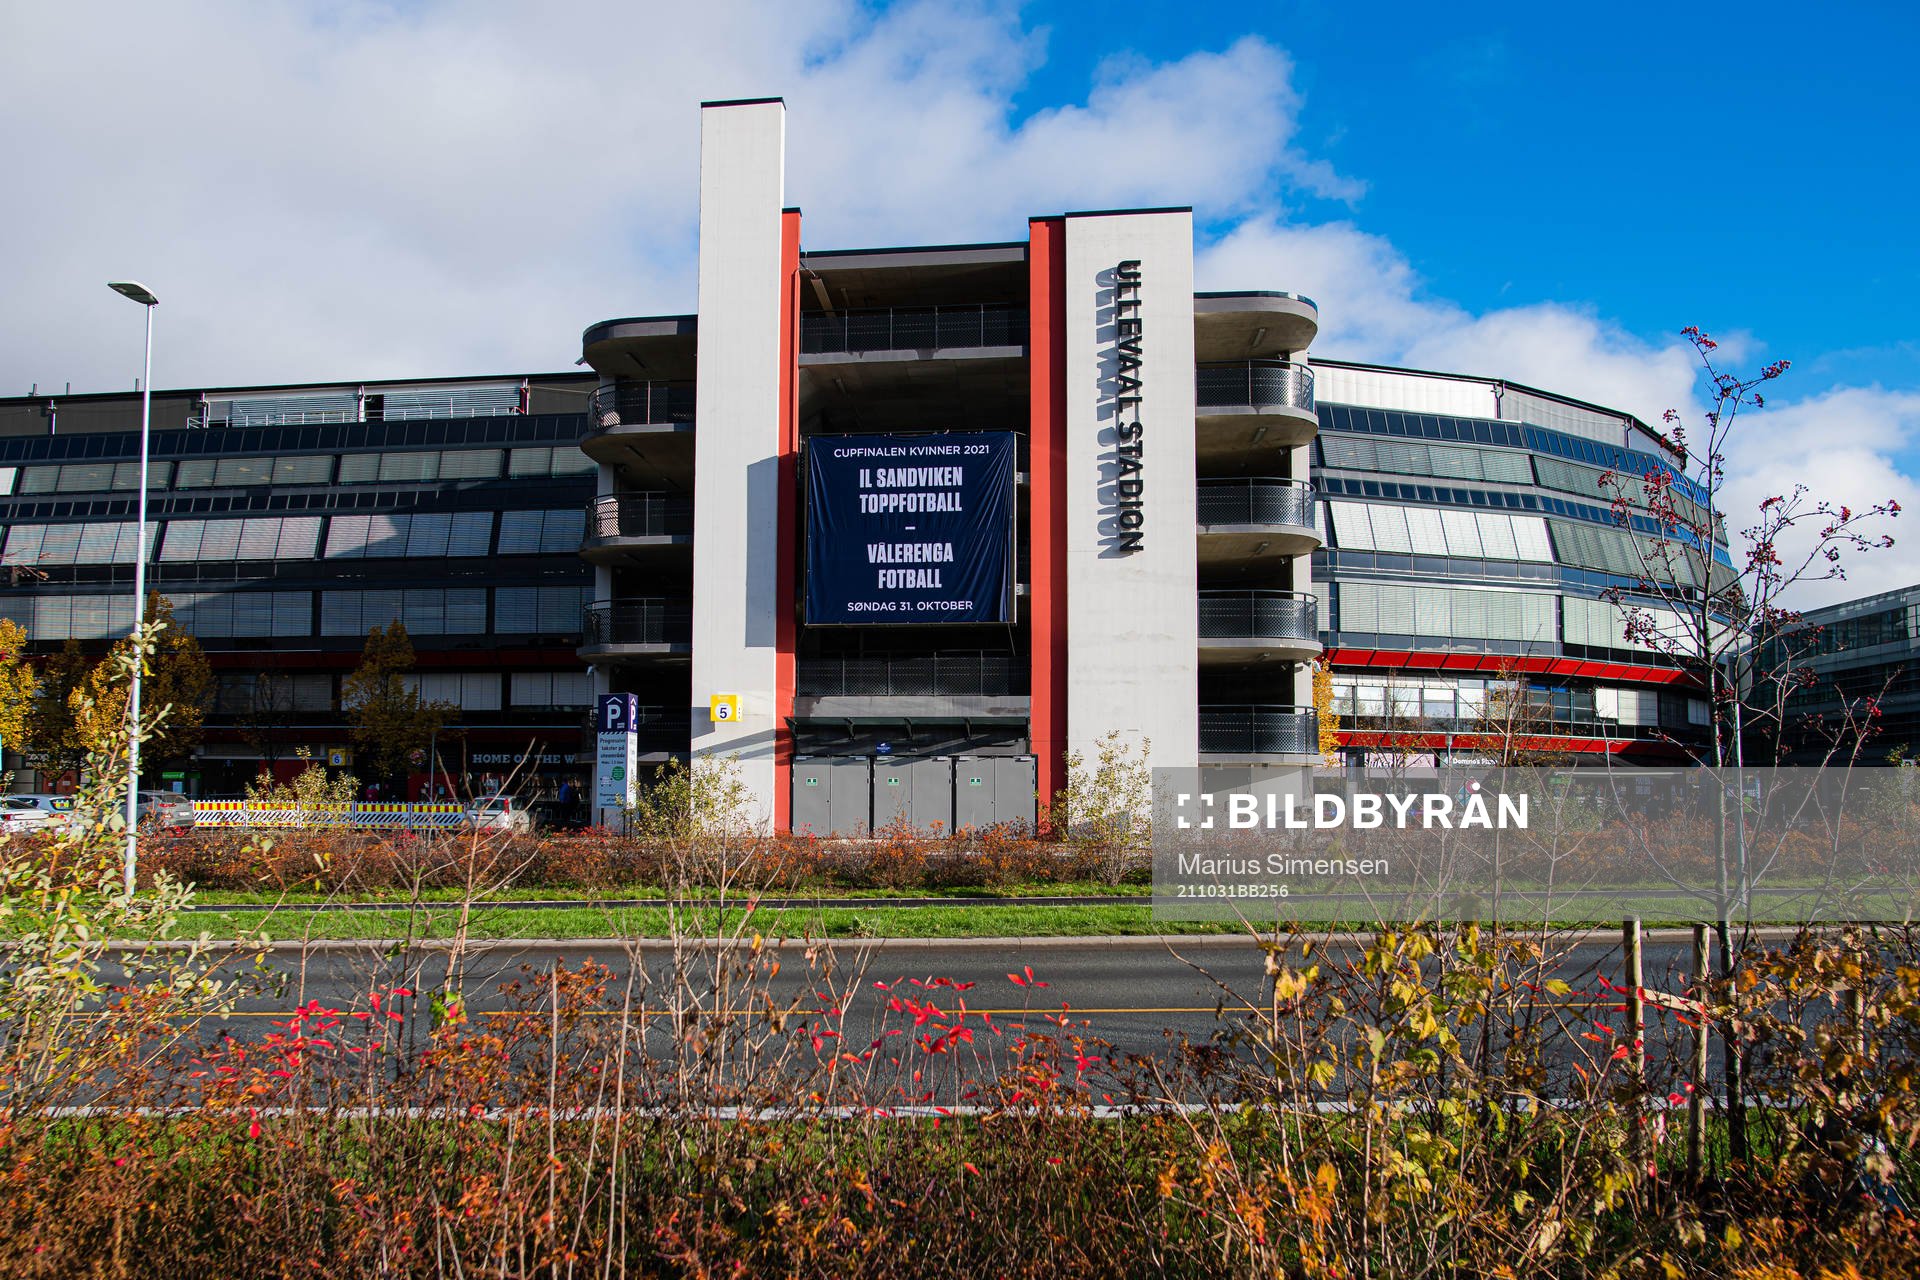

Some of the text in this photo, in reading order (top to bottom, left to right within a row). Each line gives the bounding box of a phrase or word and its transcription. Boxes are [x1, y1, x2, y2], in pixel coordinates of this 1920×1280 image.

[1117, 260, 1144, 553] ULLEVAAL STADION
[833, 444, 990, 458] CUPFINALEN KVINNER 2021
[859, 466, 963, 488] IL SANDVIKEN
[859, 492, 963, 513] TOPPFOTBALL
[867, 541, 954, 563] VÅLERENGA
[878, 568, 942, 589] FOTBALL
[847, 600, 973, 612] SØNDAG 31. OKTOBER
[607, 704, 621, 729] P
[719, 707, 728, 719] 5
[334, 755, 340, 764] 6
[472, 754, 512, 763] HOME
[534, 754, 561, 763] THE
